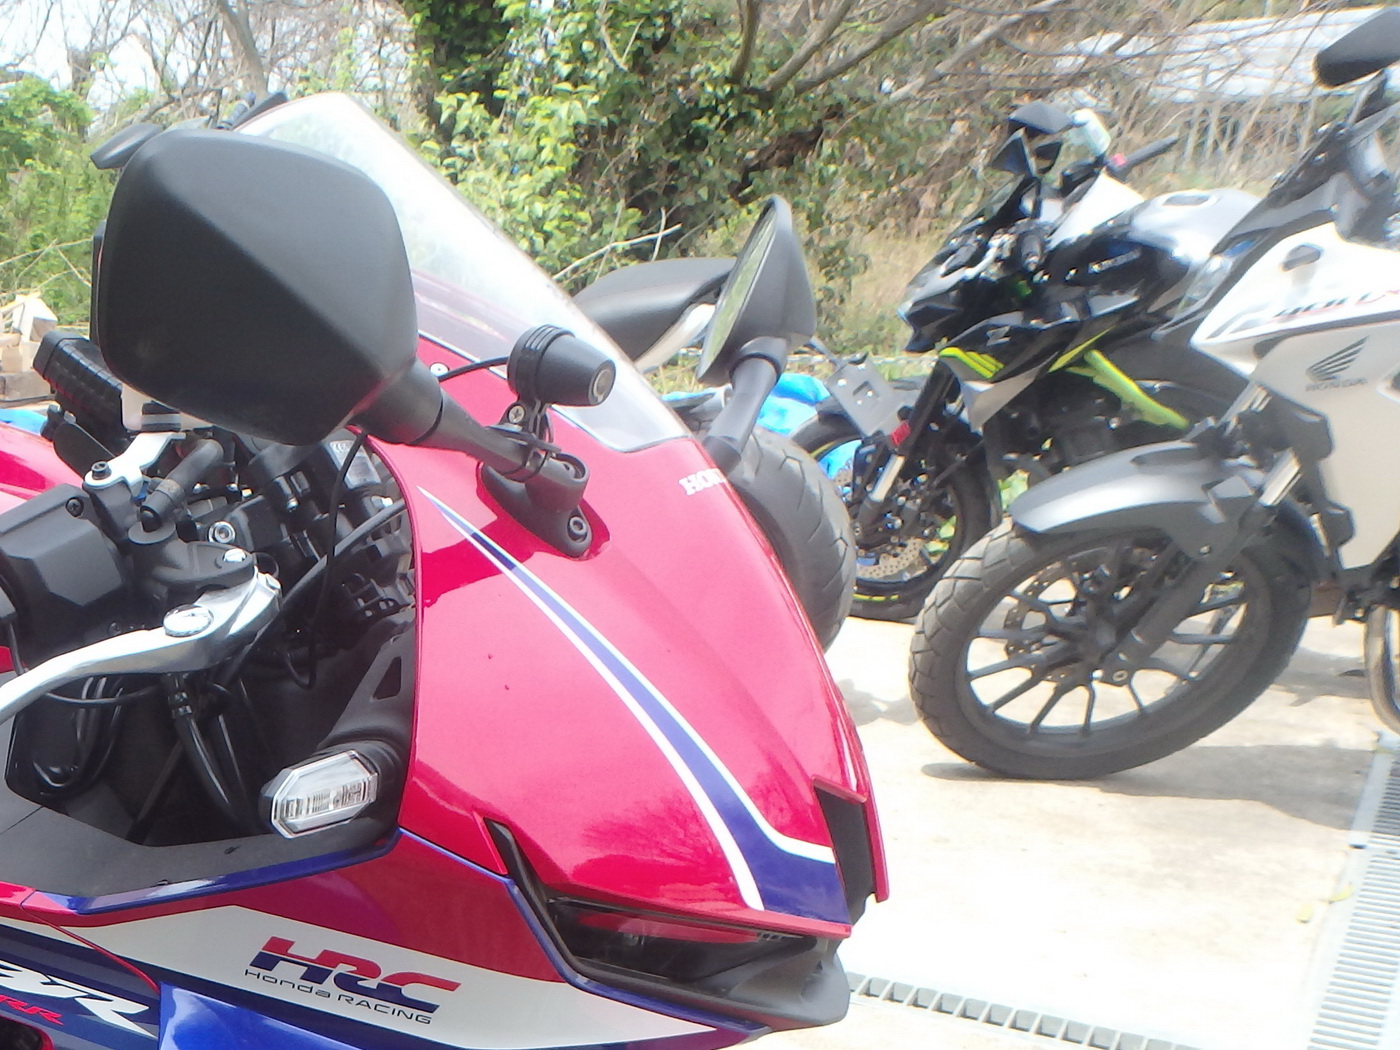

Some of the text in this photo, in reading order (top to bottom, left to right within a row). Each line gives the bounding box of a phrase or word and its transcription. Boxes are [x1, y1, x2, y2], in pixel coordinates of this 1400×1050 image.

[244, 968, 433, 1025] Honda RACING
[249, 935, 462, 1014] HRC
